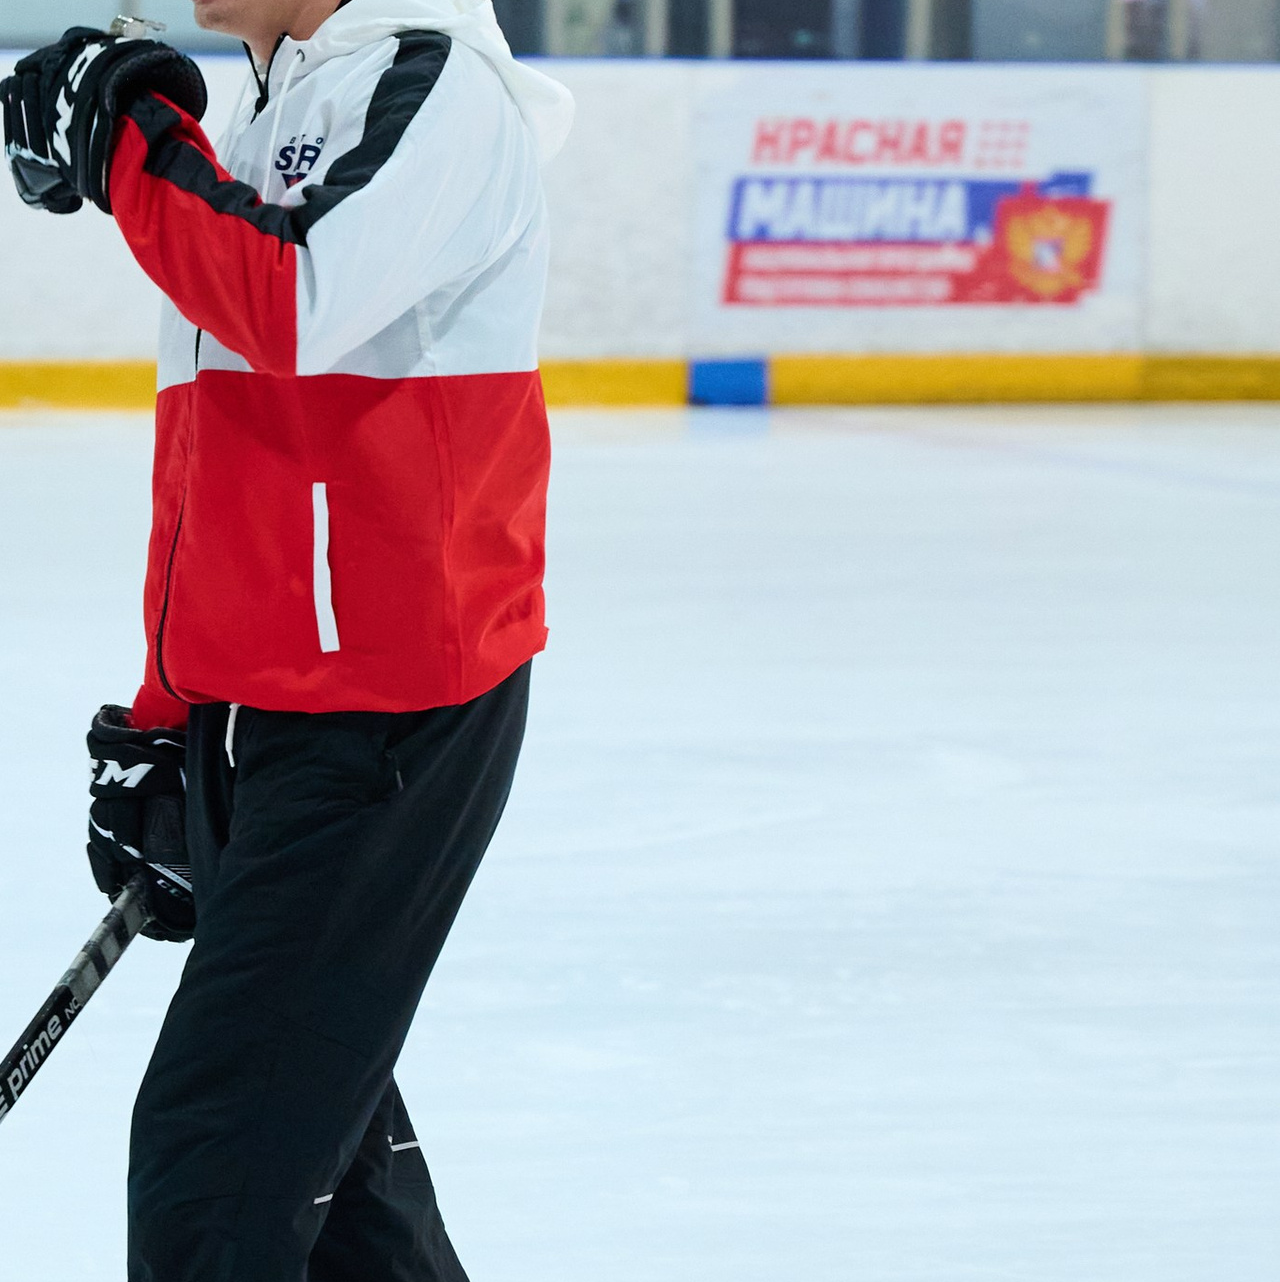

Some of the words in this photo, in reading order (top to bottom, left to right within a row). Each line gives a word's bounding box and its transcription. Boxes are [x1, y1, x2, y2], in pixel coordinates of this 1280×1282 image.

[751, 119, 967, 164] КРАСНАЯ
[740, 179, 967, 239] МАШИНА
[7, 1015, 62, 1101] prime
